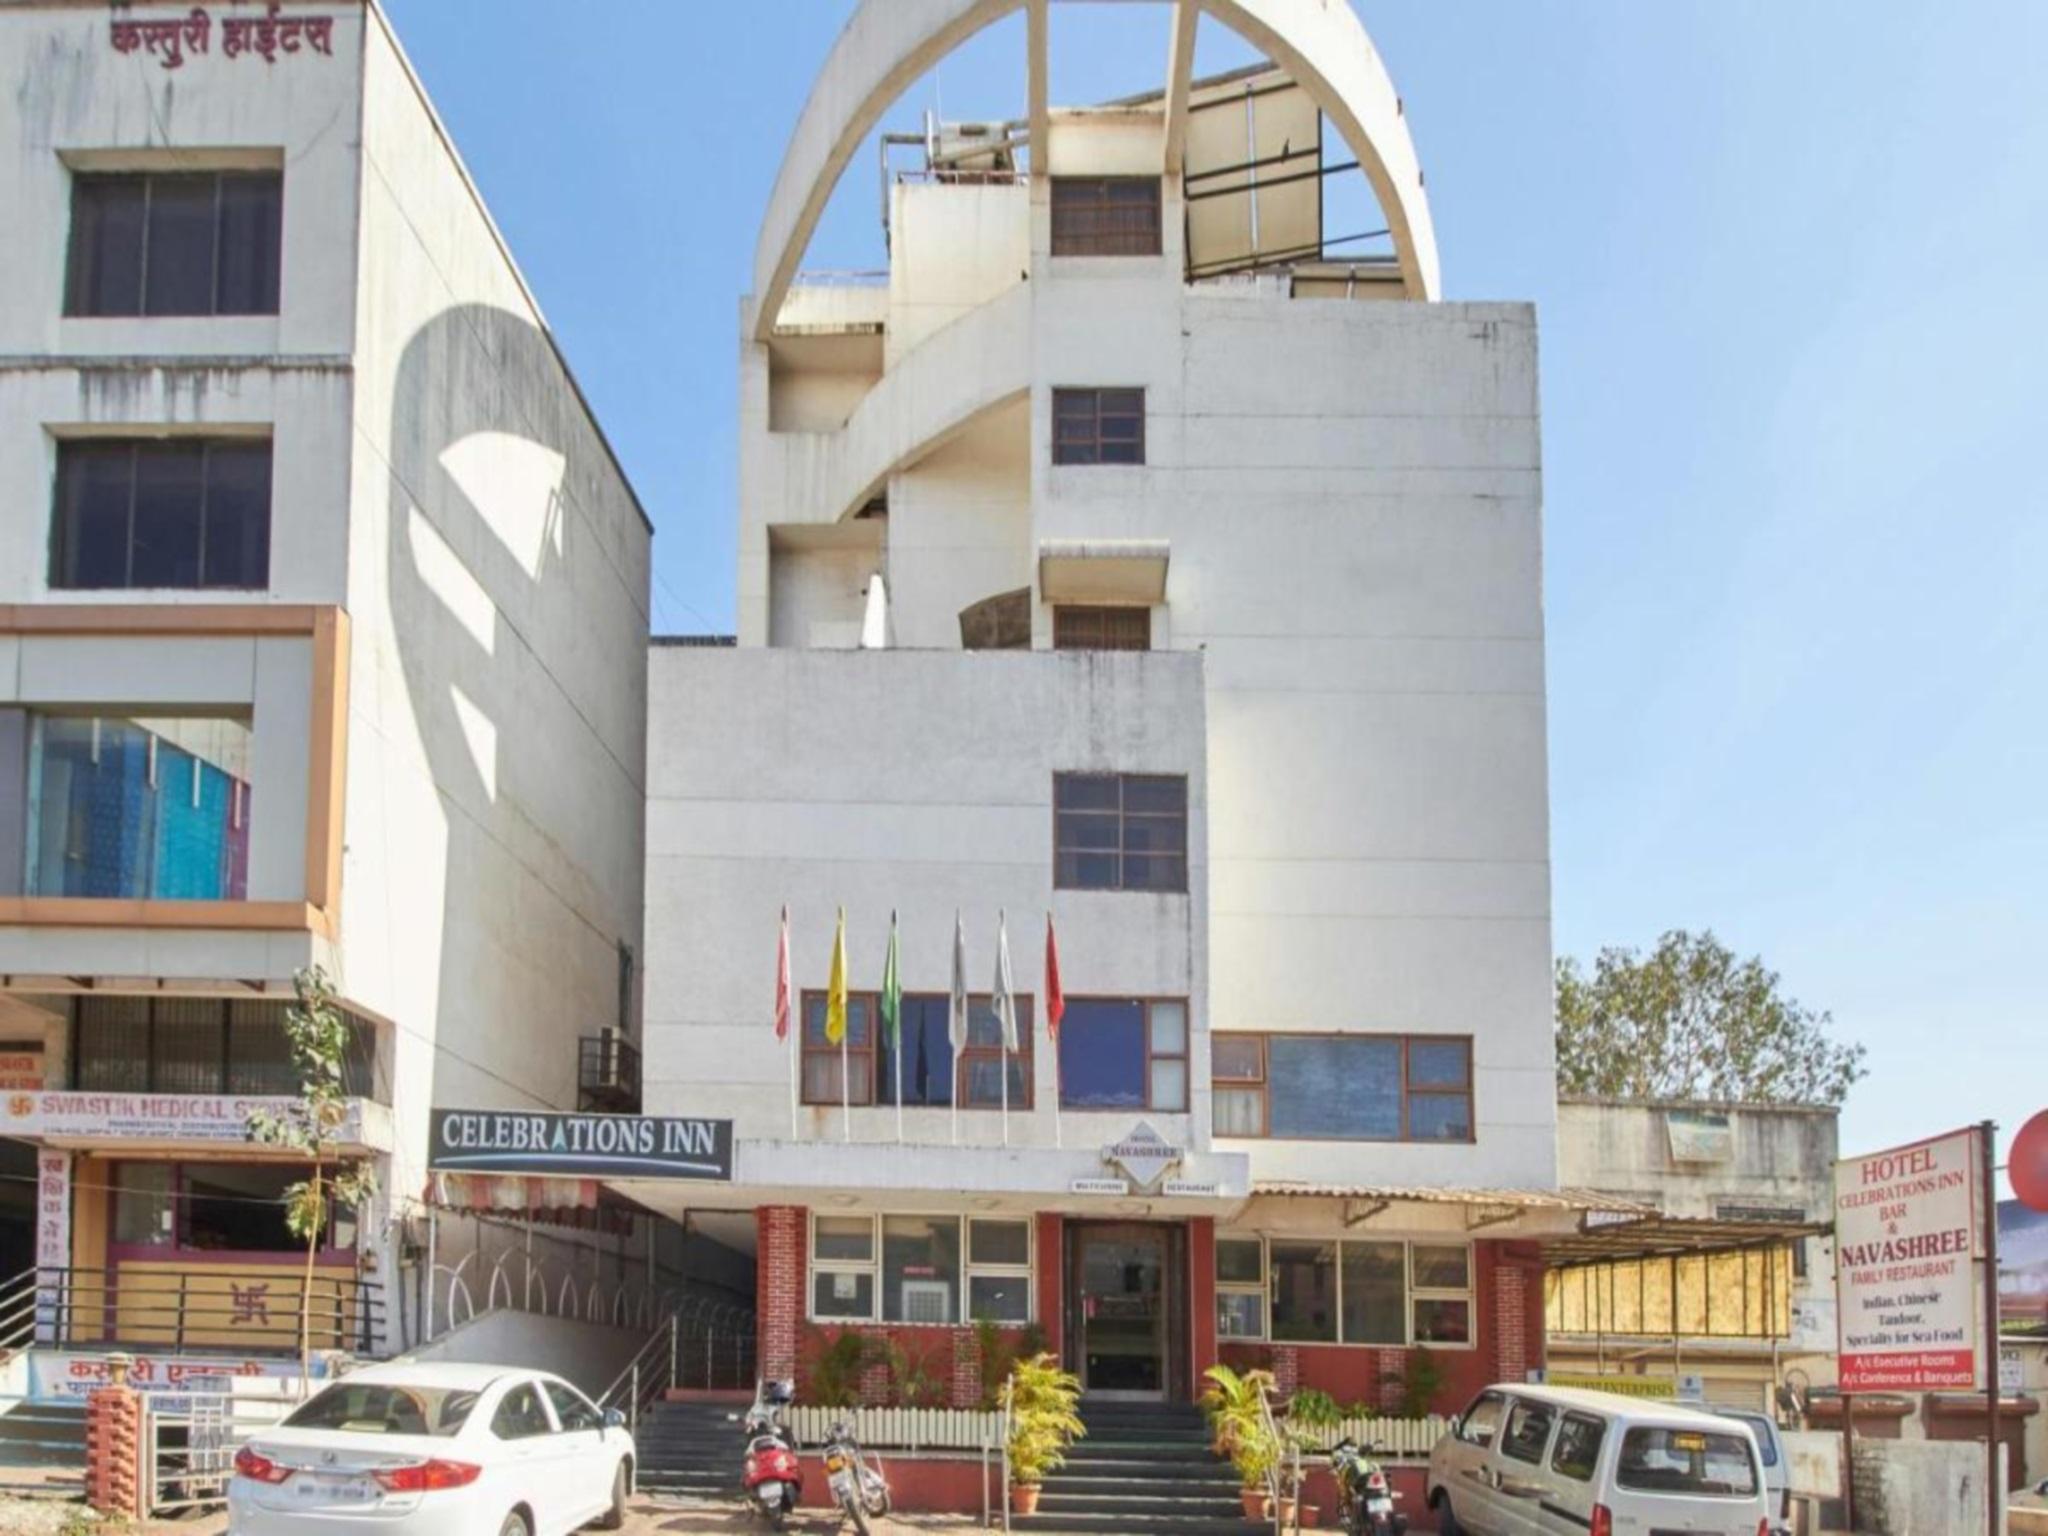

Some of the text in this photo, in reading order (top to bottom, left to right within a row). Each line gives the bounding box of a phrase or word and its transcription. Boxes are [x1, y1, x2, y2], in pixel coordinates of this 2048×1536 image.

[110, 7, 211, 68] कस्तुरी
[41, 1095, 134, 1115] SWASTIK
[141, 1097, 228, 1119] MEDICAL
[443, 1114, 716, 1155] CELEBRATIONS INN
[1861, 1148, 1937, 1185] HOTEL
[1839, 1170, 1965, 1209] CELEBRATIONS INN
[1879, 1203, 1907, 1221] BAR
[1888, 1223, 1899, 1234] &
[1841, 1228, 1969, 1268] NAVASHREE
[1851, 1260, 1956, 1286] FAMILY RESTAURANT
[1895, 1333, 1909, 1344] for
[1912, 1331, 1932, 1343] Sea
[1934, 1328, 1964, 1342] Food
[1873, 1355, 1918, 1368] Executive
[1921, 1354, 1955, 1366] Rooms
[1860, 1372, 1912, 1384] Conference
[1914, 1371, 1922, 1383] &
[1923, 1371, 1973, 1387] Banquets
